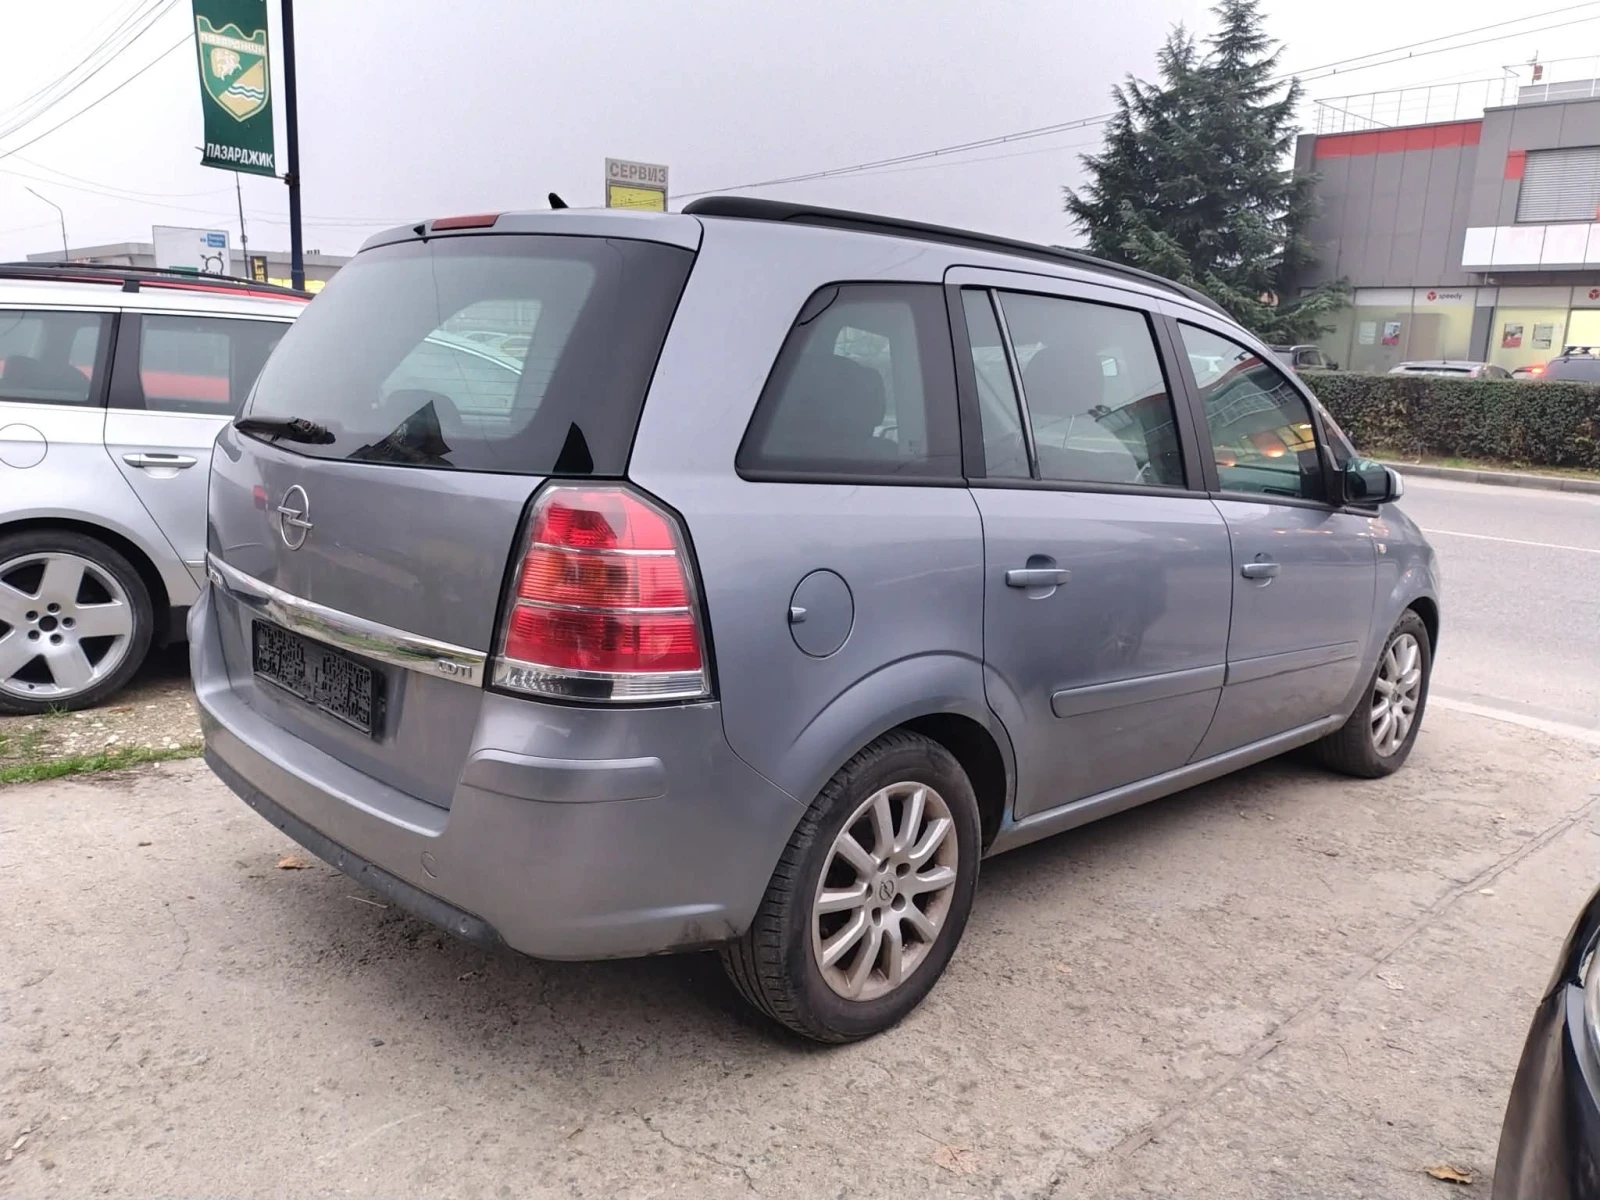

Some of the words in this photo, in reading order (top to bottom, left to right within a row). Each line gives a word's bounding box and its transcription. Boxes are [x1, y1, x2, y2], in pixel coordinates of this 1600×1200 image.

[206, 143, 274, 168] ПАЗАРДЖИК
[609, 162, 666, 183] СЕРВИЗ
[1439, 292, 1462, 300] speedy
